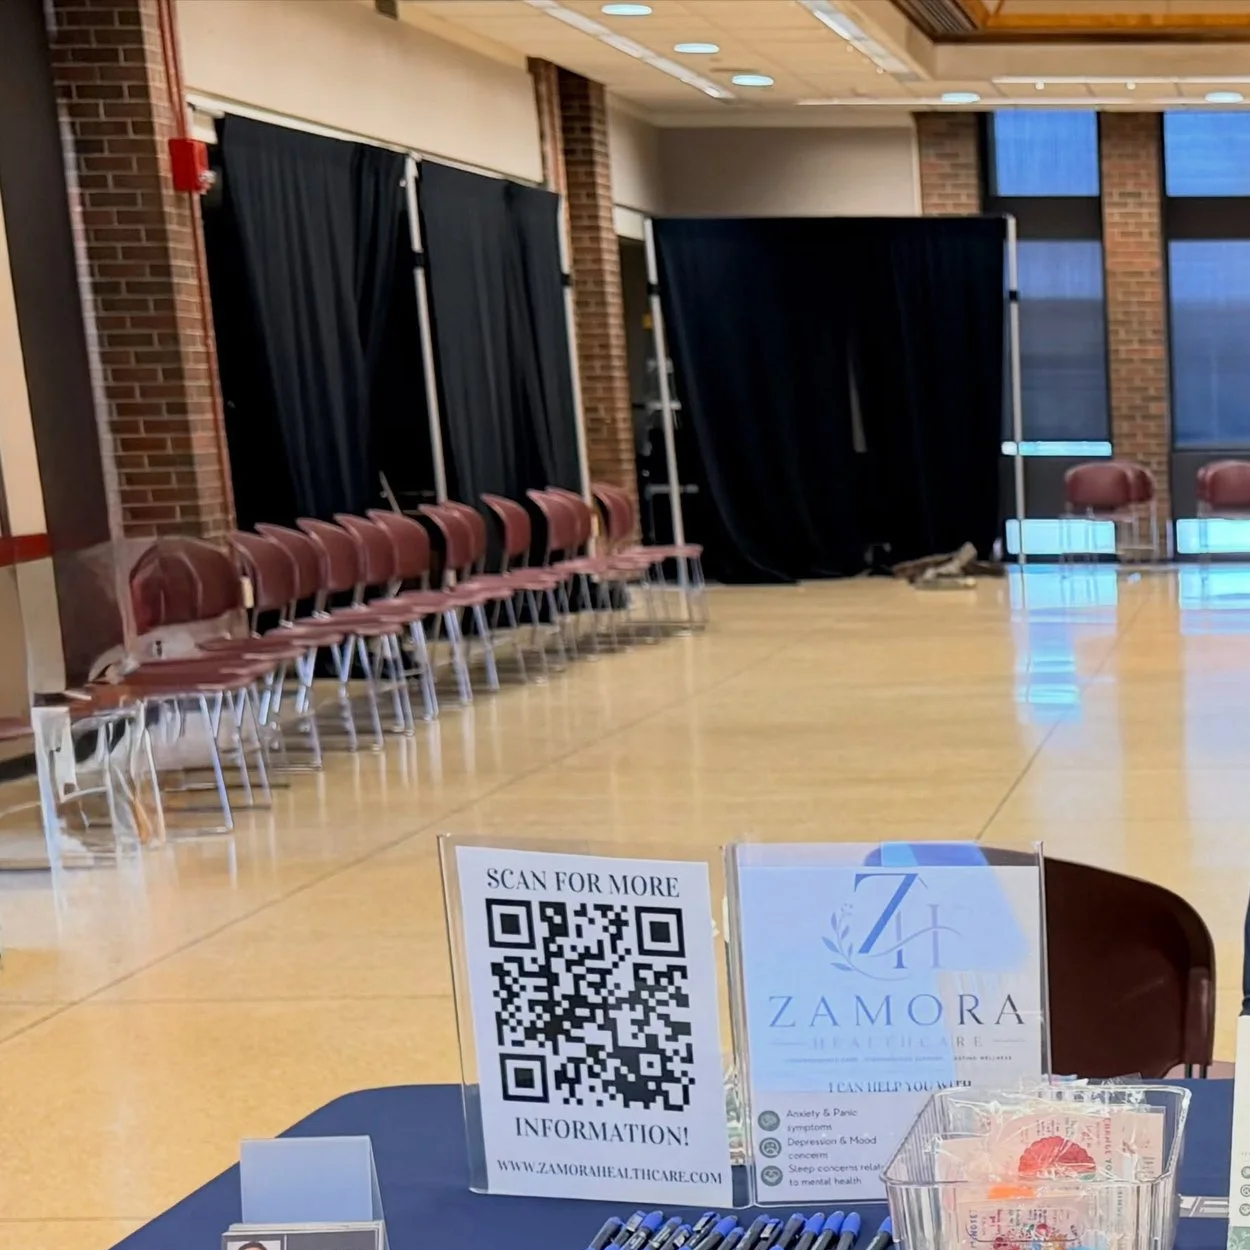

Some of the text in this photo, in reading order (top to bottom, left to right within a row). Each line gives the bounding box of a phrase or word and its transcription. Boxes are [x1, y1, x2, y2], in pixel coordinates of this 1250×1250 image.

[486, 867, 680, 898] SCAN FOR MORE
[768, 993, 1026, 1029] ZAMORA
[837, 1081, 864, 1094] CAN
[867, 1080, 902, 1093] HELP
[905, 1080, 933, 1092] YOU
[786, 1110, 820, 1119] Anxiety
[833, 1108, 858, 1117] Panic
[514, 1116, 690, 1147] INFORMATION!
[787, 1124, 833, 1133] symptoms
[787, 1137, 837, 1147] Depression
[850, 1136, 877, 1145] Mood
[497, 1158, 723, 1185] WWW.ZAMORAHEALTHCARE.COM
[788, 1164, 815, 1173] Sleep
[861, 1163, 884, 1171] relat
[801, 1178, 832, 1186] mental
[834, 1177, 862, 1185] health
